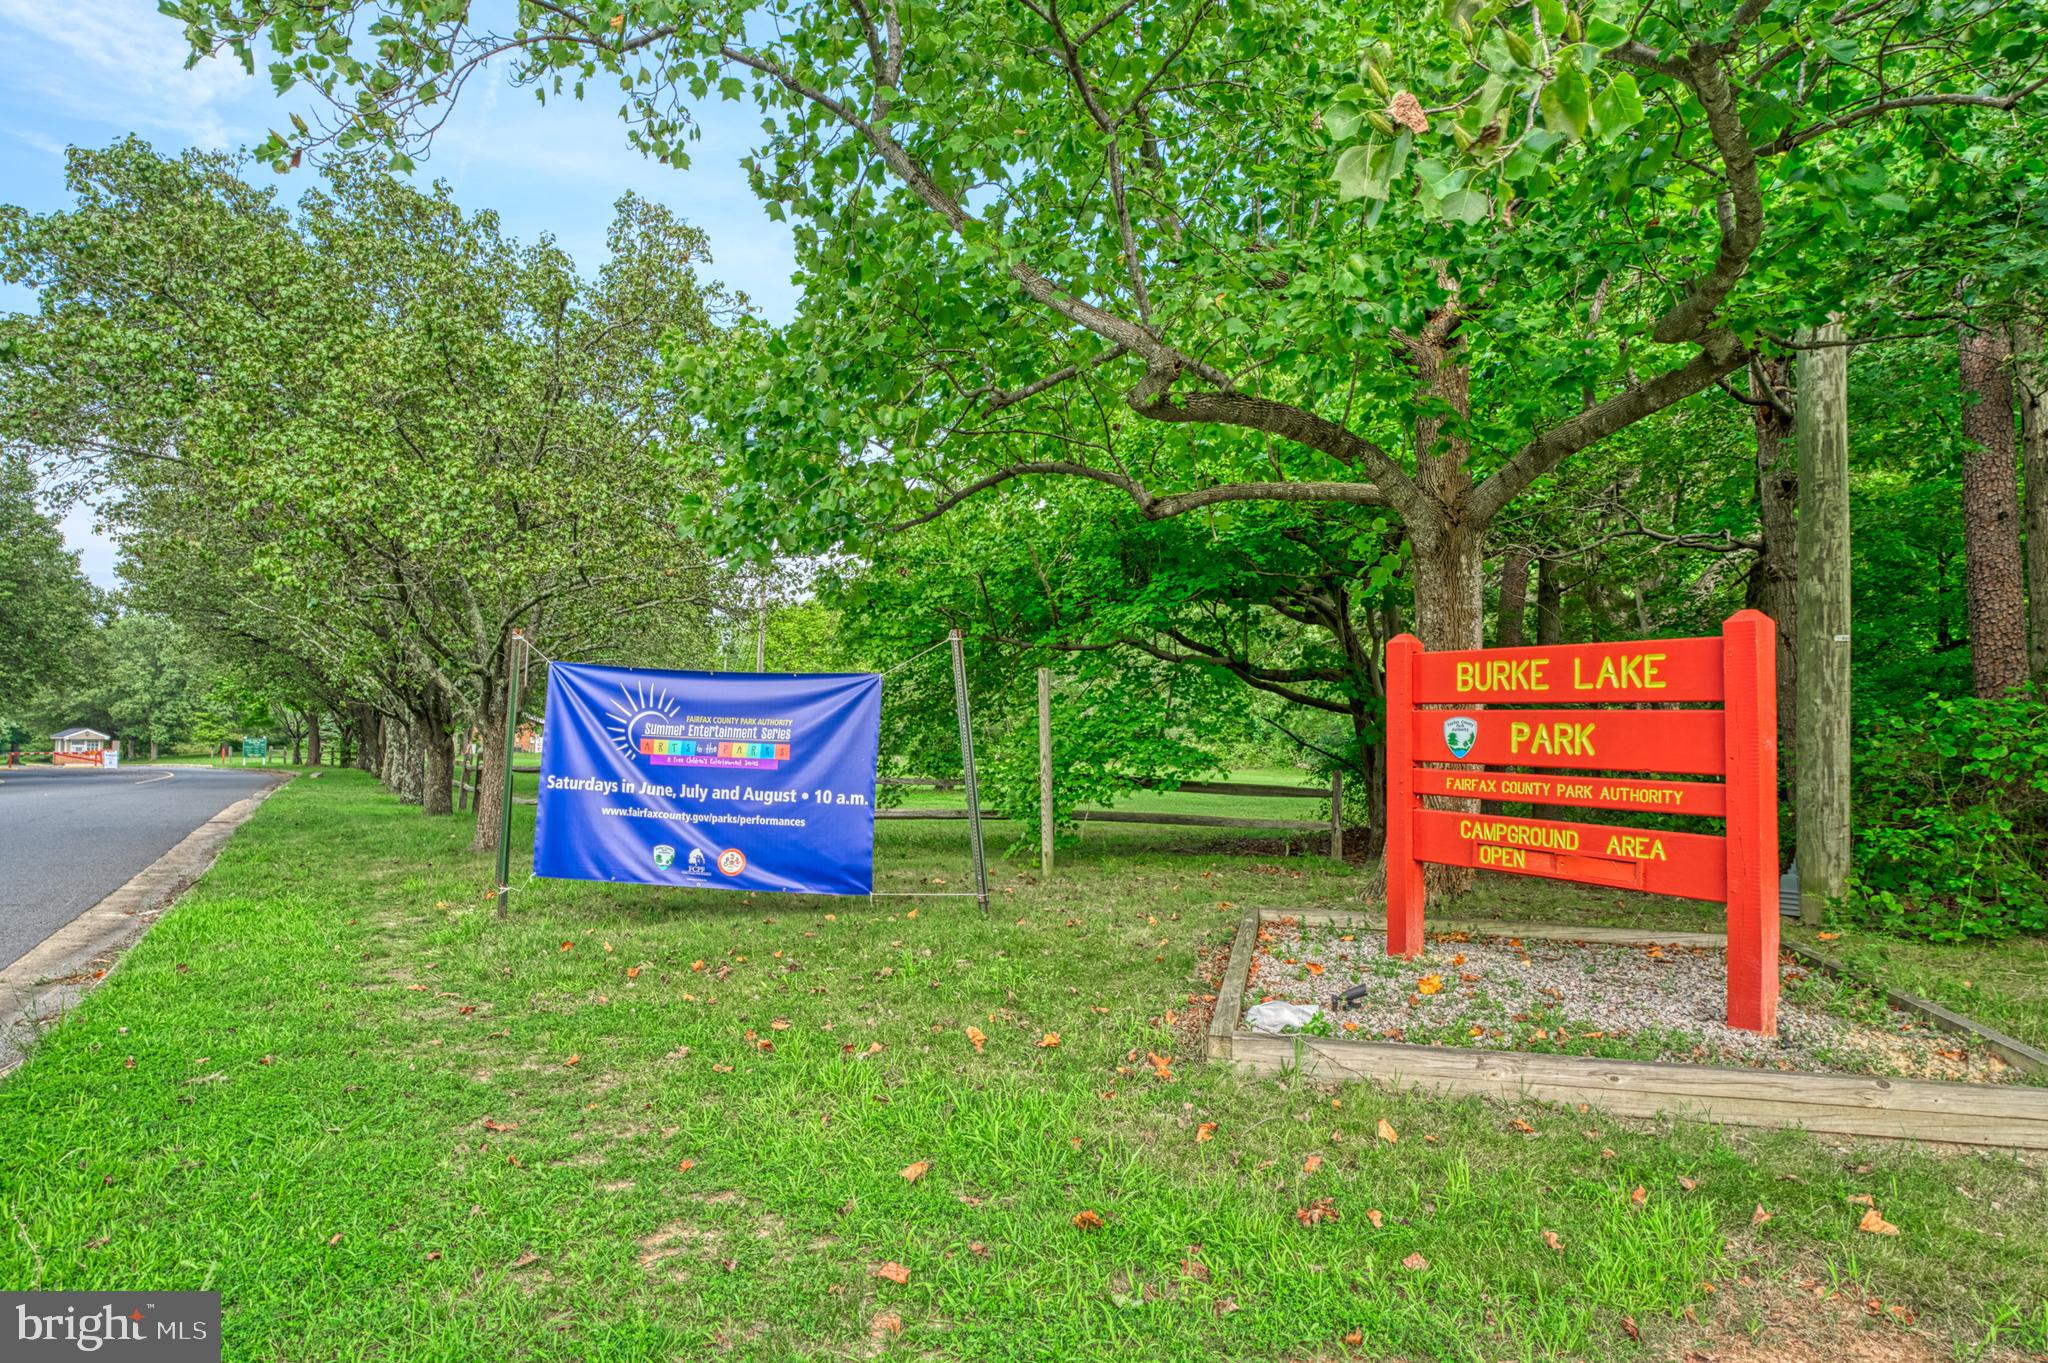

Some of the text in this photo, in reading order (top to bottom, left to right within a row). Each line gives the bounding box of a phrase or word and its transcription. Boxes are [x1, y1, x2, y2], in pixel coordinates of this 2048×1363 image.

[1456, 653, 1667, 692] BURKE LAKE
[645, 722, 791, 740] Summer Entertainment Series
[686, 715, 793, 727] FAIRFAX COUNTY PARK AUTHORITY
[643, 741, 692, 753] ARTS
[706, 742, 717, 754] the
[722, 744, 786, 758] PARKS
[1511, 721, 1596, 756] PARK
[547, 775, 869, 805] Saturdays in June, July and August 10 a.m.
[1446, 777, 1684, 805] FAIRFAX COUNTY PARK AUTHORITY
[601, 806, 806, 827] www.fairfaxcounty.gov/parks/performances
[1460, 820, 1667, 861] CAMPGROUND AREA
[1479, 845, 1526, 869] OPEN
